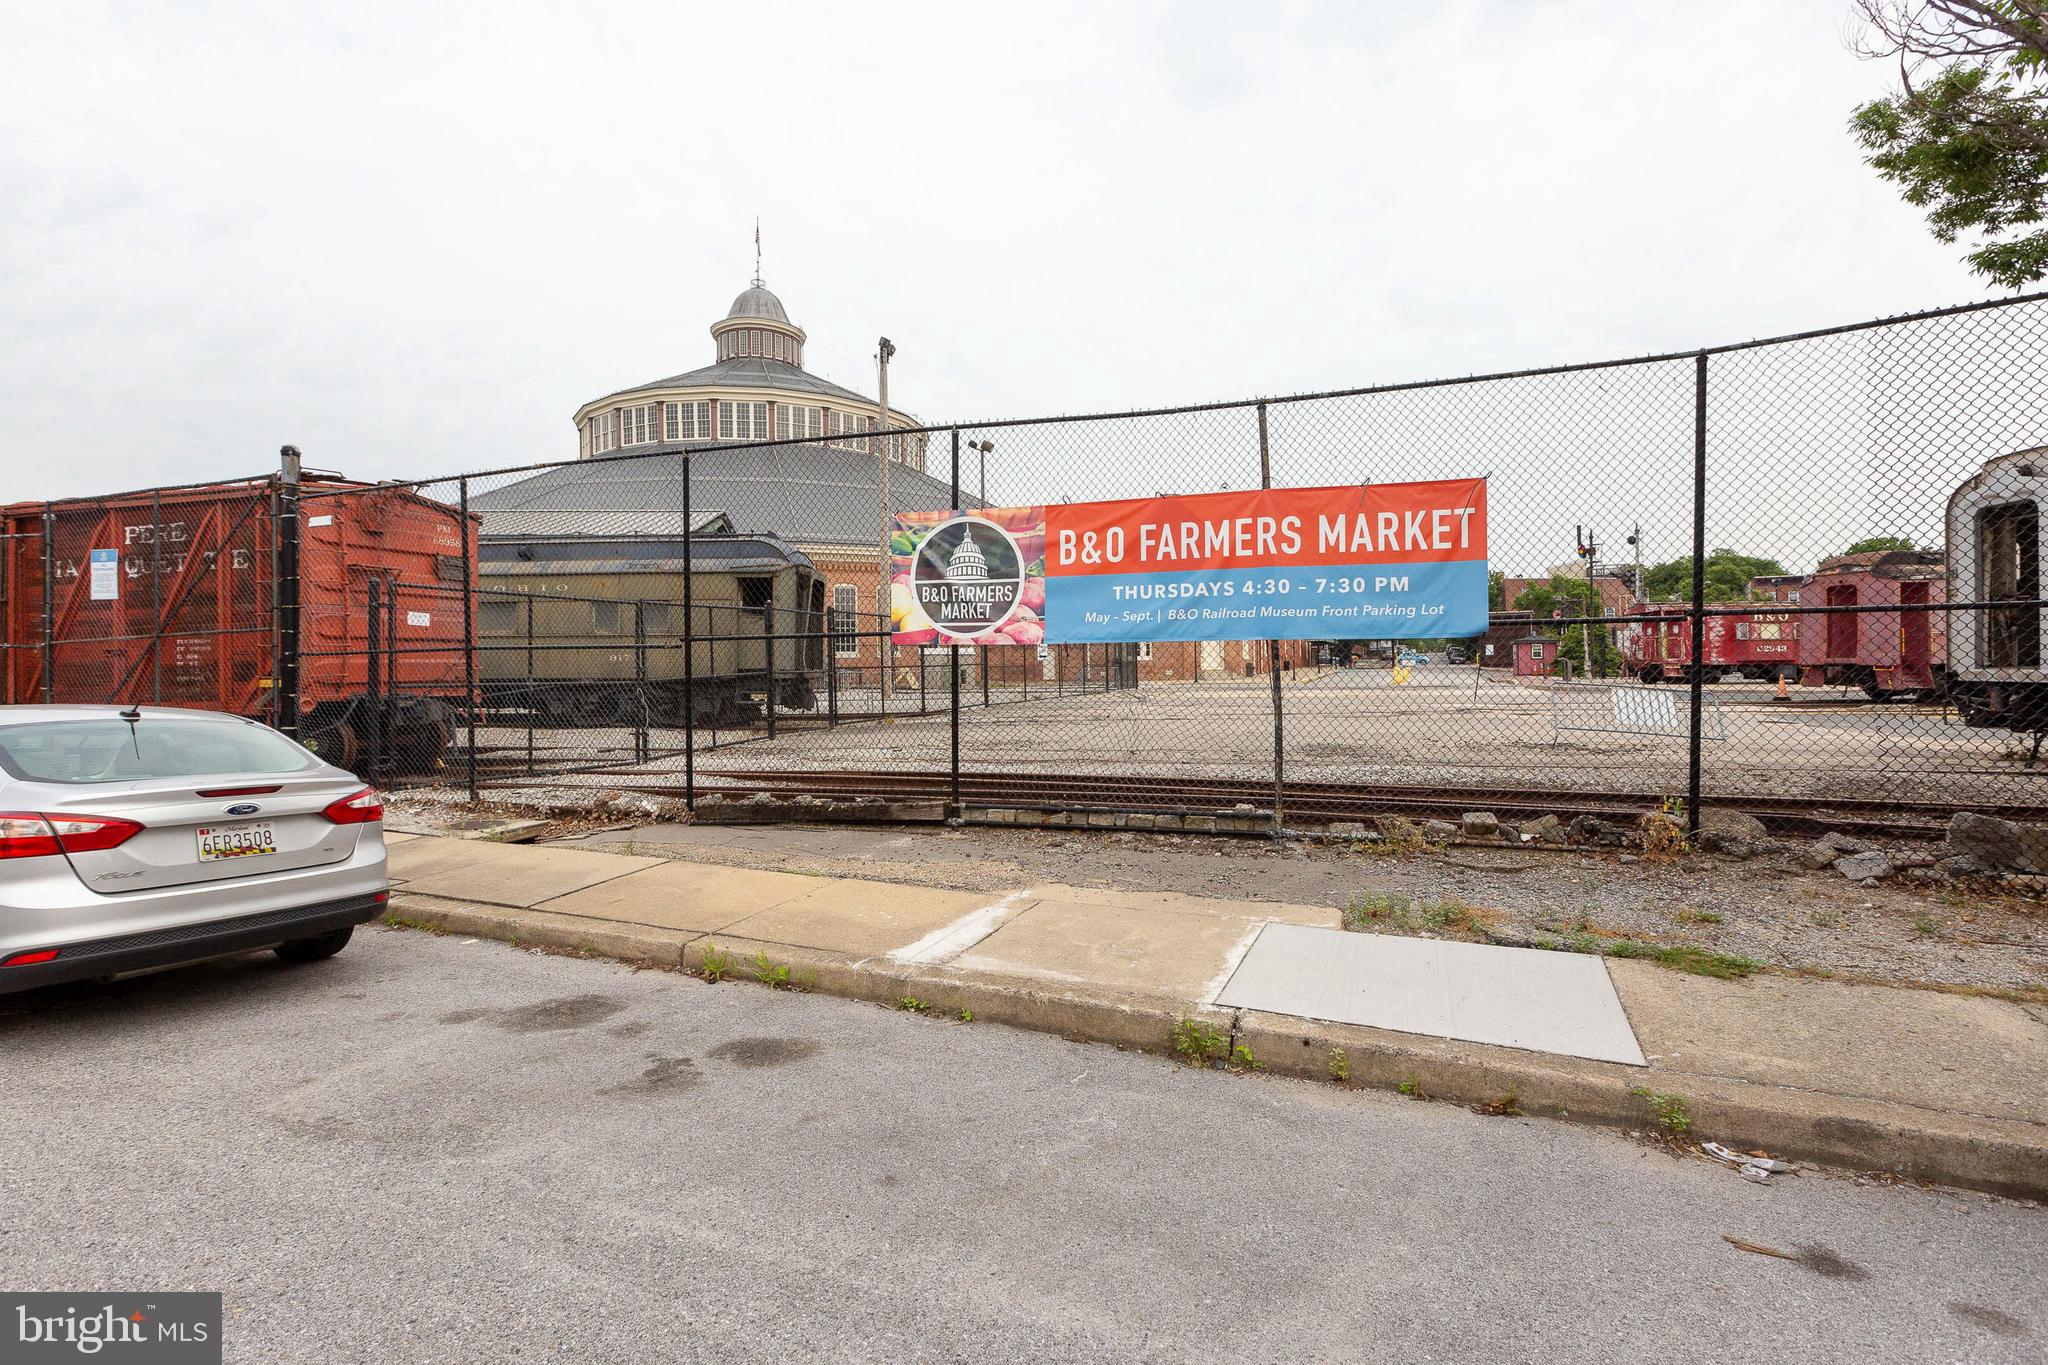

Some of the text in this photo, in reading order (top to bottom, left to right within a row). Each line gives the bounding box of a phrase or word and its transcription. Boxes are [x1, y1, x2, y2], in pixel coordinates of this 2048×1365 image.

[124, 521, 187, 545] PERE
[1059, 507, 1476, 565] B&O FARMERS MARKET
[922, 585, 1013, 602] B&O FARMERS
[1113, 581, 1235, 600] THURSDAYS
[1242, 578, 1290, 595] 4:30
[1315, 577, 1366, 594] 7:30
[1375, 576, 1409, 592] PM
[941, 602, 993, 619] MARKET
[1085, 612, 1111, 624] May
[1123, 611, 1154, 625] Sept.
[1168, 608, 1198, 621] B&O
[1202, 606, 1256, 619] Railroad
[1260, 605, 1317, 618] Museum
[1322, 604, 1358, 617] Front
[1362, 603, 1416, 618] Parking
[1421, 603, 1445, 616] Lot
[203, 830, 273, 852] 6ER3508
